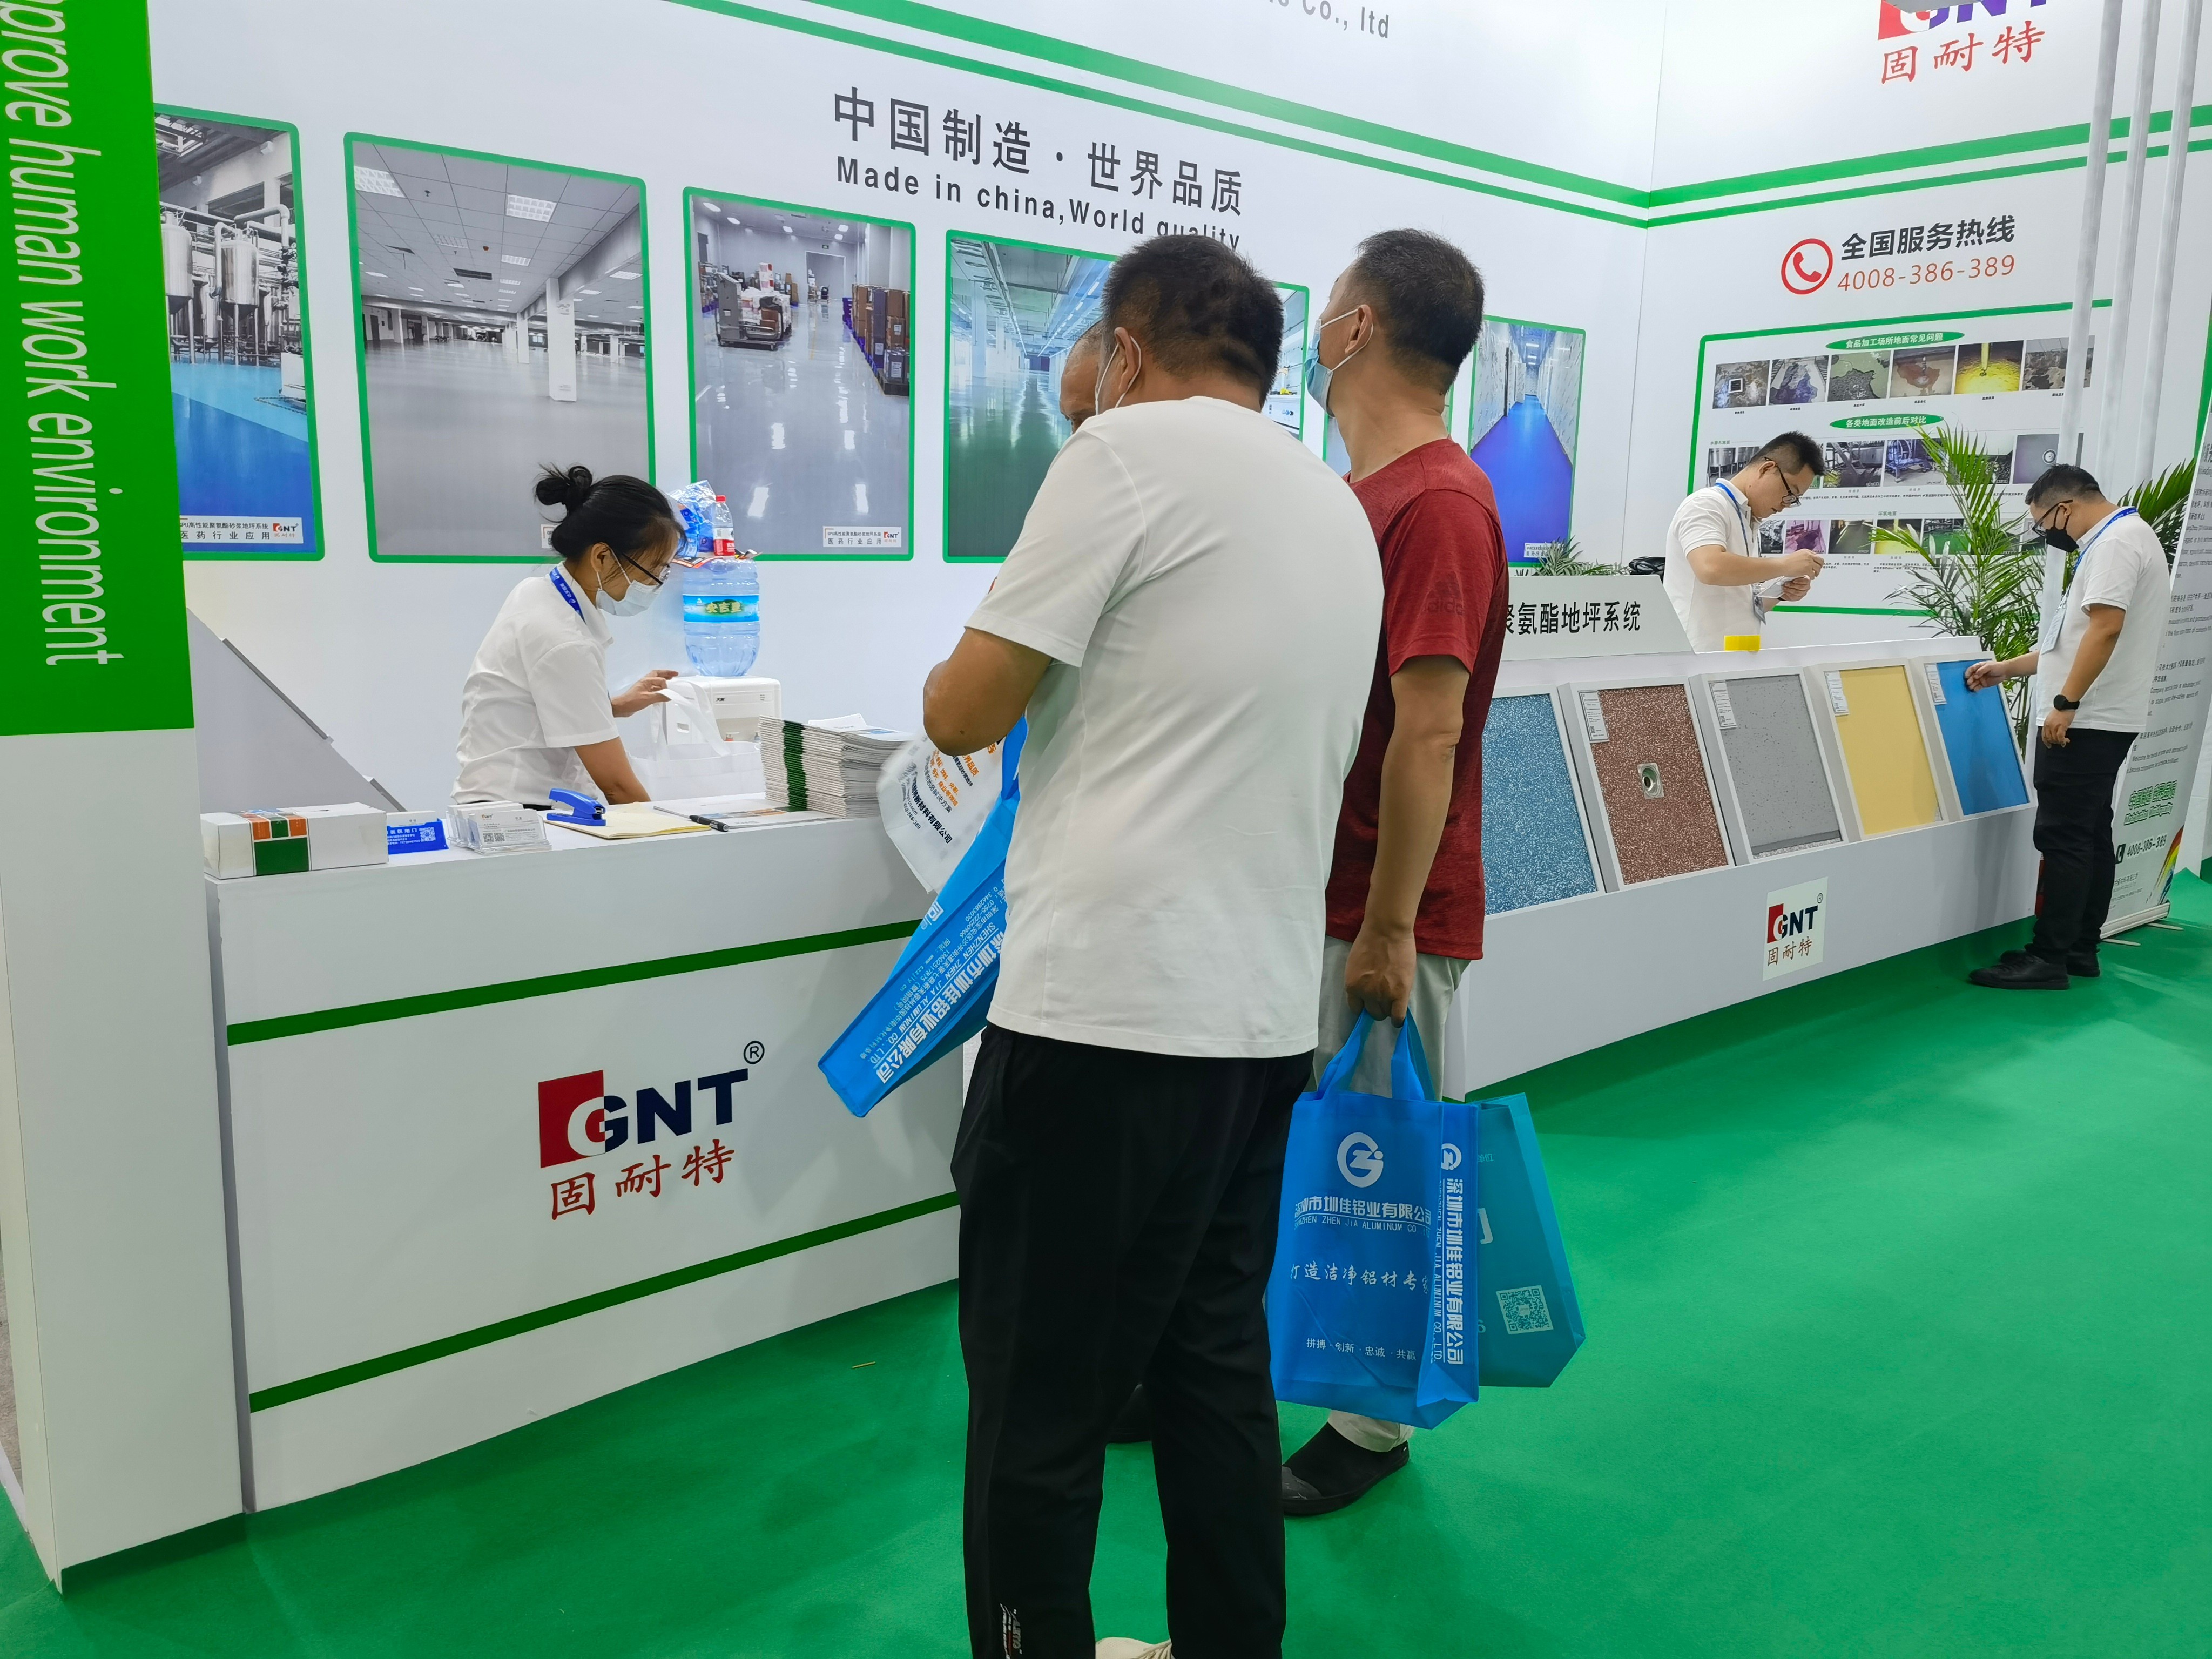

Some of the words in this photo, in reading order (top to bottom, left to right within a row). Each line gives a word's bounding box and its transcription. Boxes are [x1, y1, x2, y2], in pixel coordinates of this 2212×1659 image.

[1361, 6, 1390, 38] ltd
[0, 0, 72, 127] prove
[1881, 21, 2046, 84] 固耐特
[837, 156, 919, 195] Made
[935, 174, 962, 202] in
[9, 138, 102, 286] human
[1841, 215, 2015, 261] 全国服务热线
[1837, 254, 2014, 291] 4008-386-389
[21, 300, 117, 401] work
[1846, 332, 1943, 348] 食品加工场所地面常见问题
[1846, 416, 1926, 427] 各类地面改造前后对比
[28, 412, 124, 665] environment
[181, 530, 270, 540] 医药行业应用
[962, 754, 980, 777] 界品质
[960, 921, 996, 960] SHENZHEN
[1773, 905, 1818, 940] GNT
[943, 959, 963, 979] ZHEN
[1768, 936, 1812, 966] 固耐特
[929, 980, 945, 995] JIA
[898, 995, 930, 1033] ALUMINUM
[568, 1068, 748, 1156] GNT
[551, 1139, 734, 1220] 固耐特
[1322, 1216, 1341, 1225] ZHEN
[1362, 1221, 1402, 1231] ALUMINUM
[1446, 1178, 1463, 1364] 深圳市圳佳铝业有限公司
